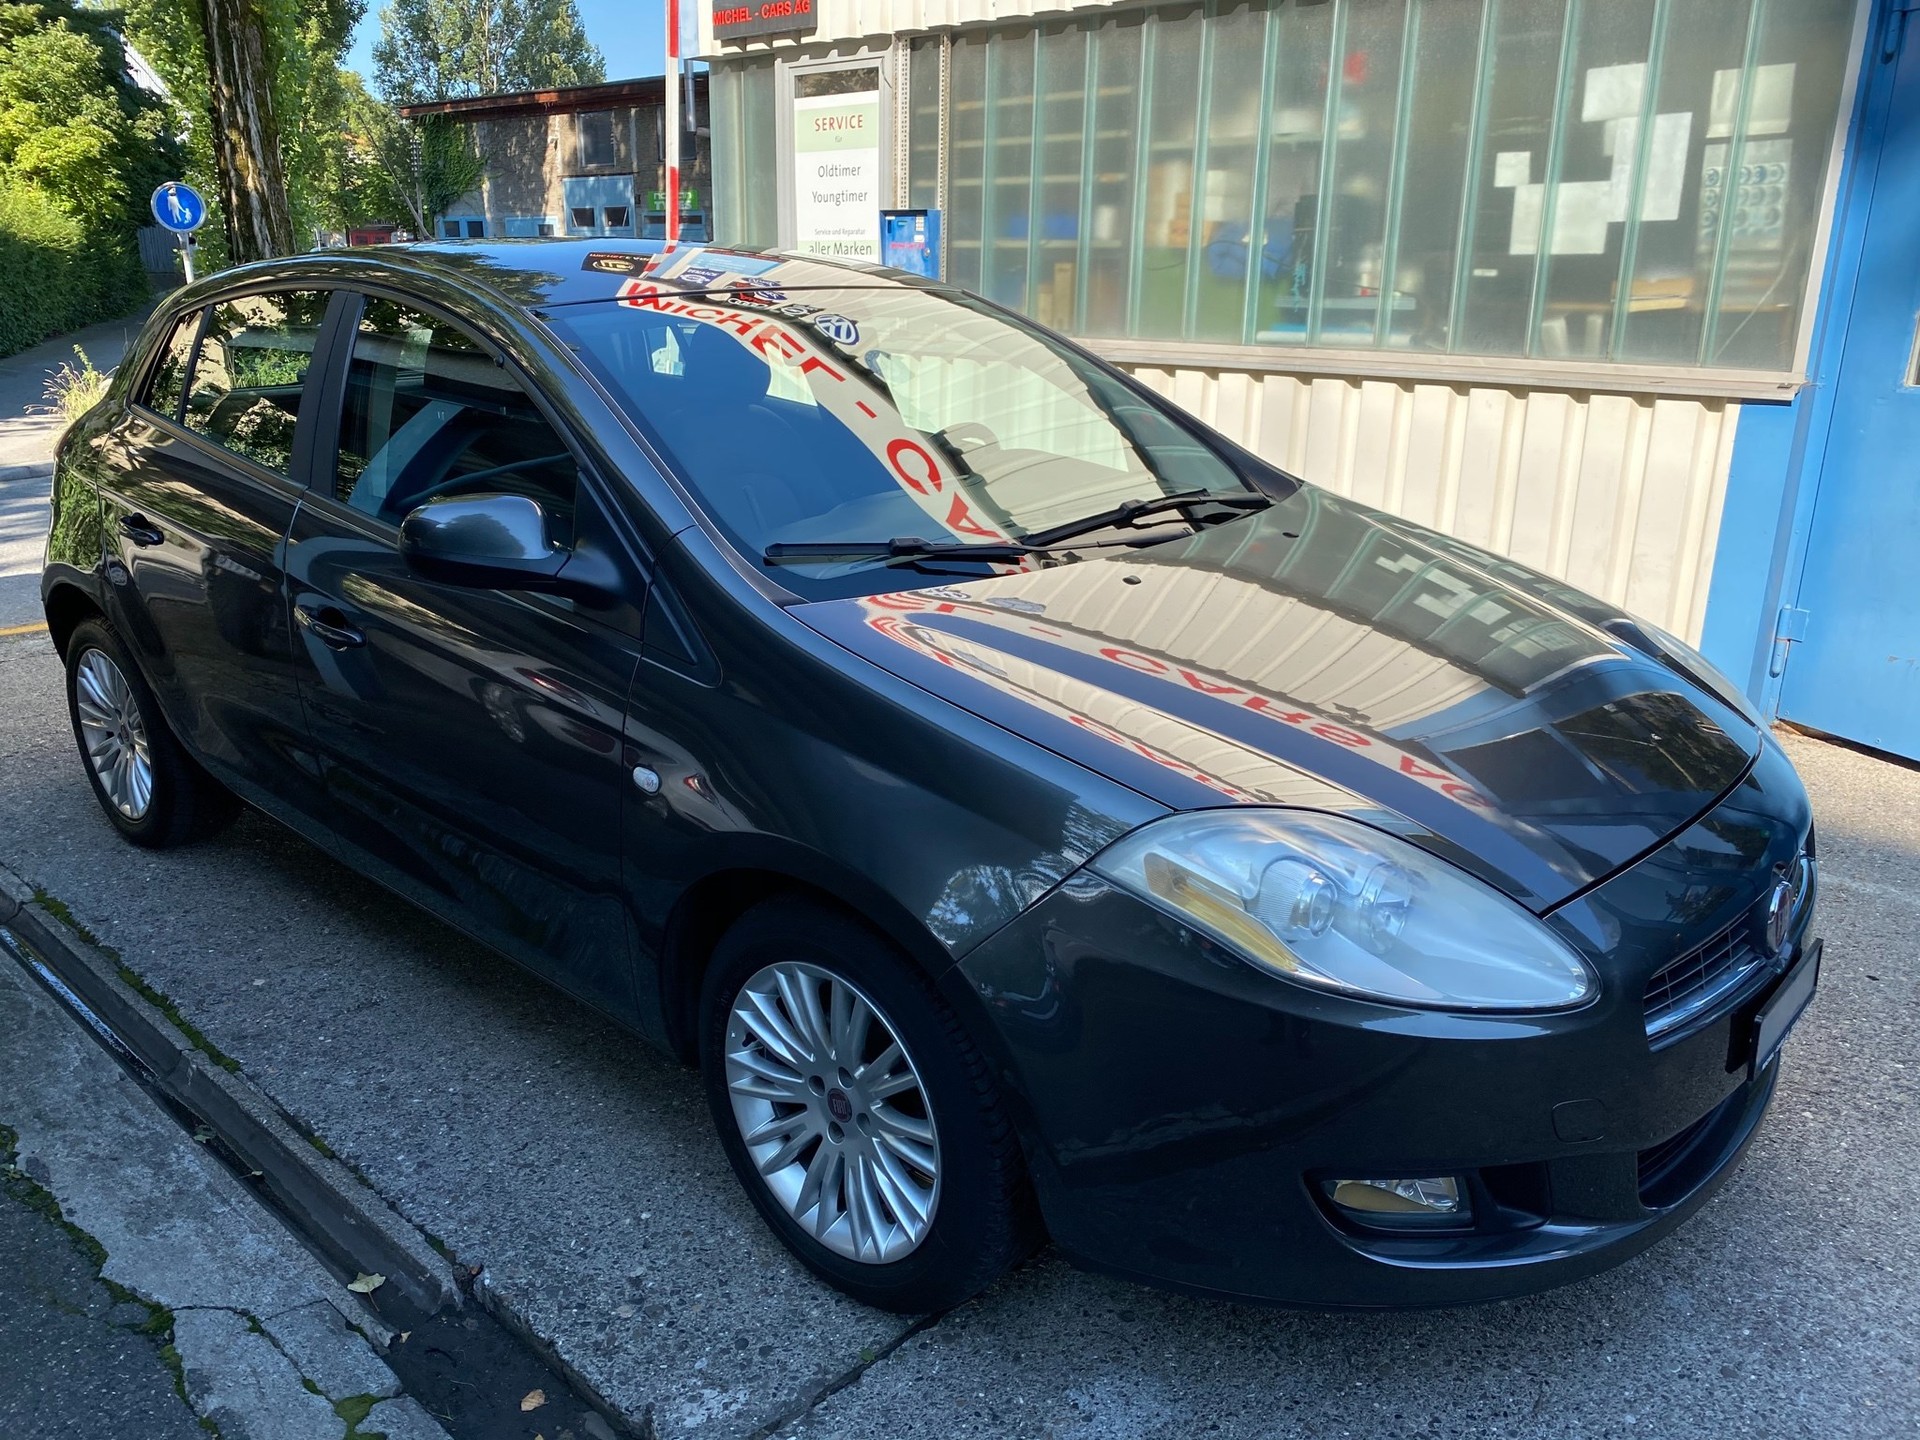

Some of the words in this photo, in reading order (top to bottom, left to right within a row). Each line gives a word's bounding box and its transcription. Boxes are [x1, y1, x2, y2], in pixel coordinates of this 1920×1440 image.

[712, 7, 752, 26] MICHEL
[761, 1, 792, 19] CARS
[794, 0, 810, 14] AG
[814, 114, 863, 132] SERVICE
[817, 164, 862, 178] Oldtimer
[812, 190, 868, 207] Youngtimer
[809, 241, 831, 255] aller
[833, 241, 872, 255] Marken
